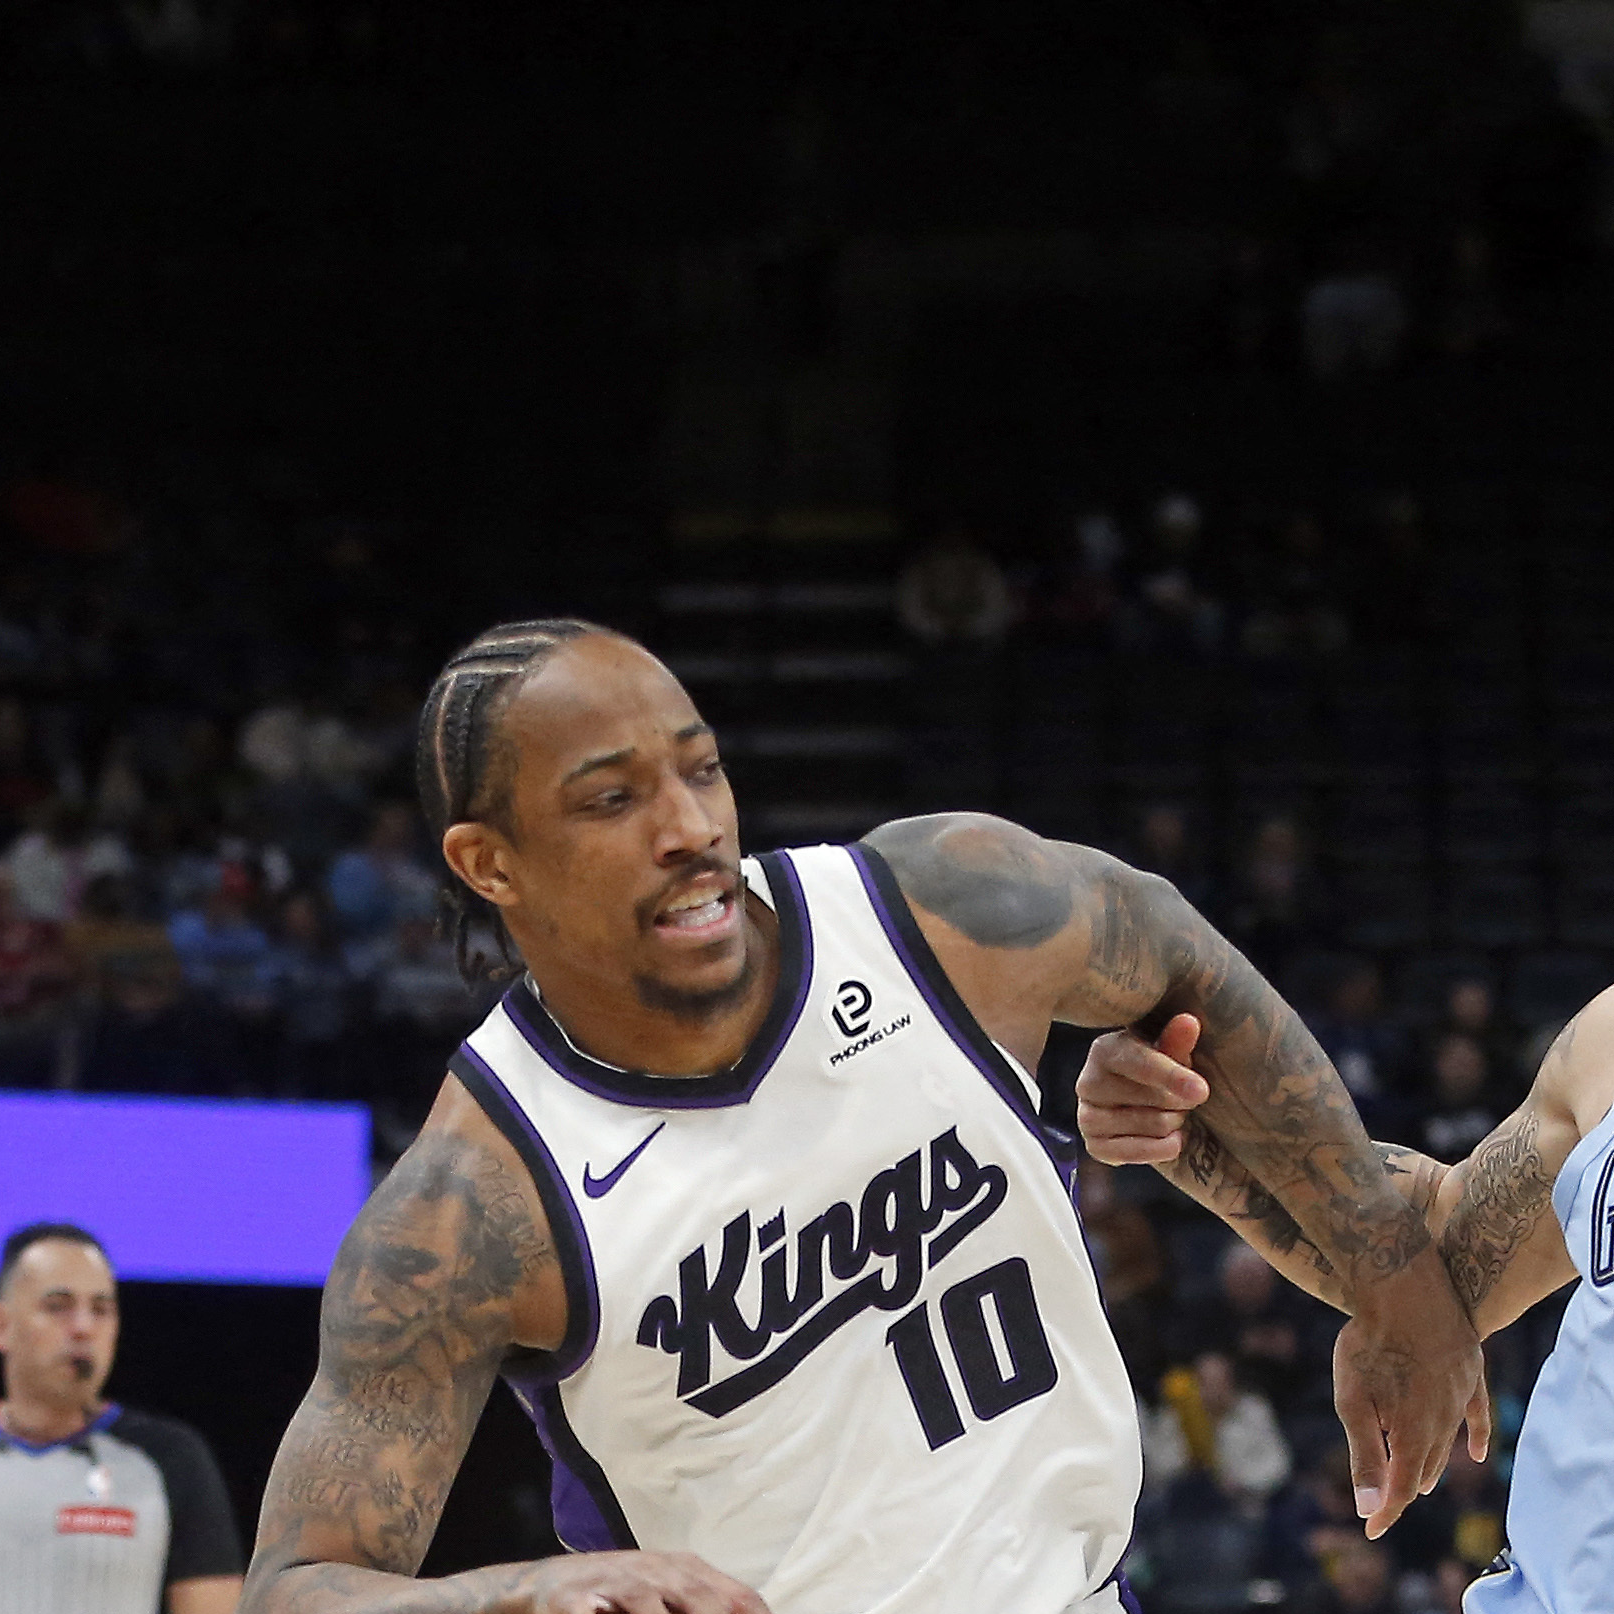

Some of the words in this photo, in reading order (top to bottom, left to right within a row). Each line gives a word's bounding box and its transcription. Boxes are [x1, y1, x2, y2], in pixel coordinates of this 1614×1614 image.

[829, 1032, 884, 1067] PHOONG
[883, 1014, 911, 1036] LAW
[636, 1126, 1010, 1418] Kings
[885, 1256, 1058, 1452] 10
